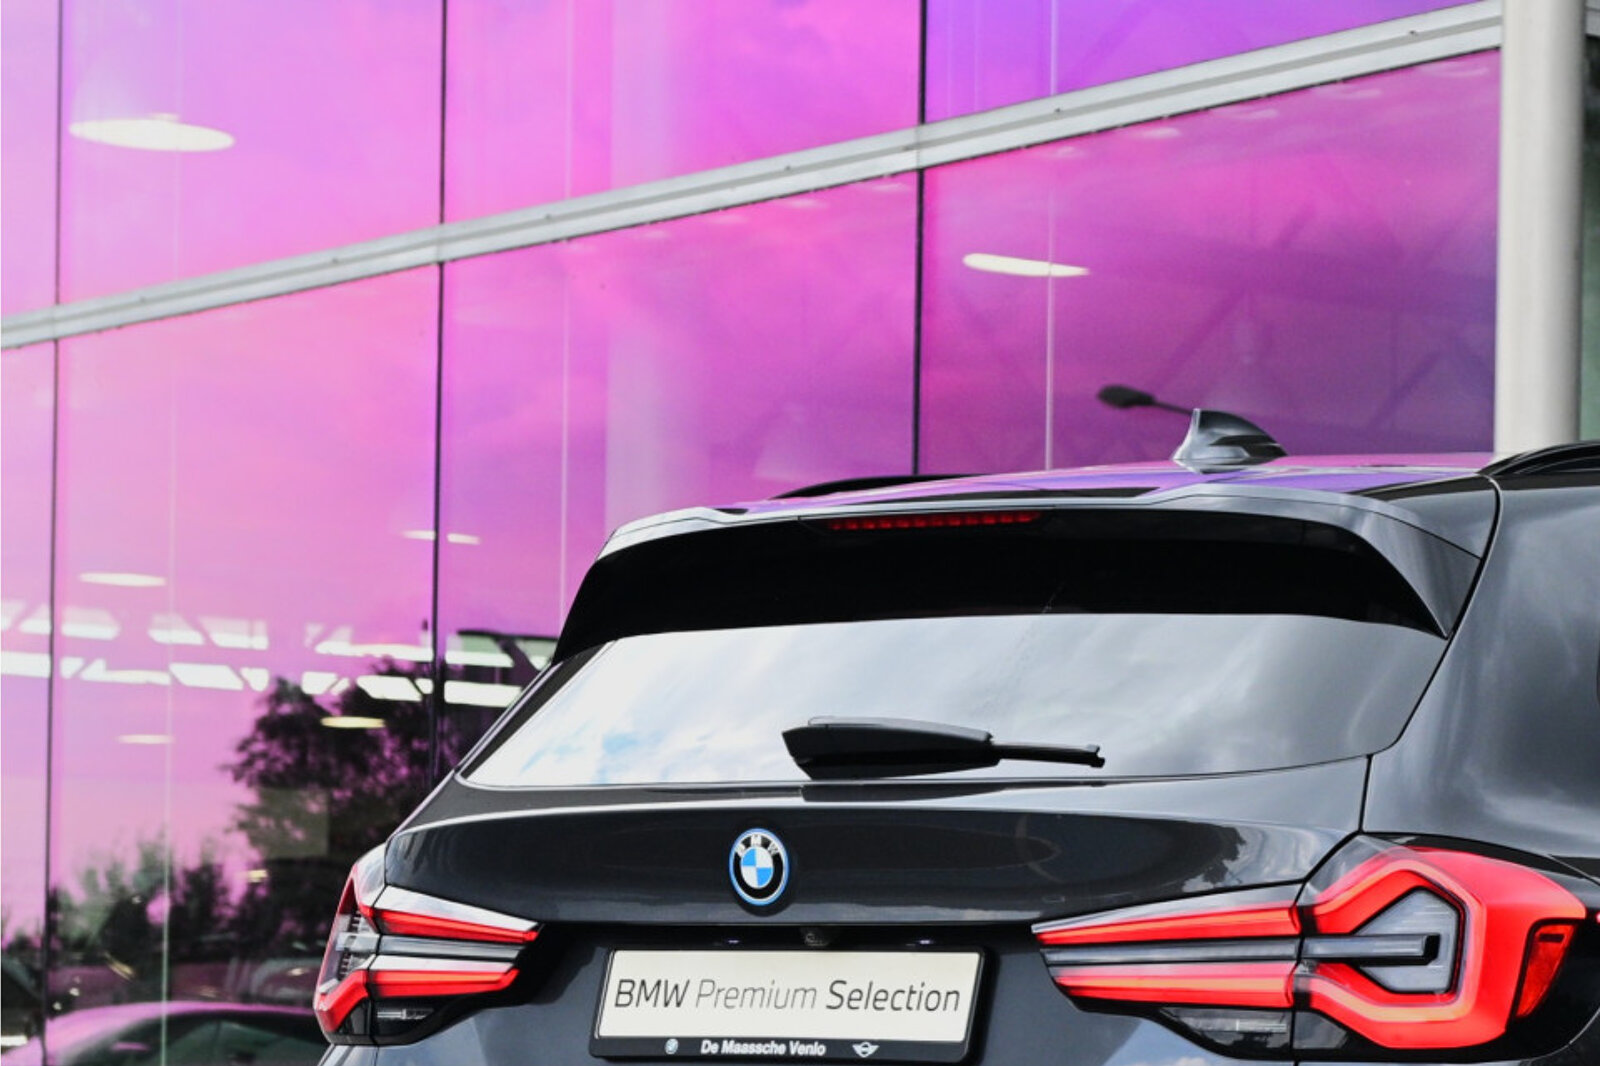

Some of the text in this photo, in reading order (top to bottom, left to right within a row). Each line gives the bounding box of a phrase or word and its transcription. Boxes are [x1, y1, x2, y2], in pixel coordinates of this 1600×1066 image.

[735, 832, 780, 857] BMW
[614, 978, 960, 1012] BMW Premium Selection
[700, 1039, 827, 1057] De Maassche Venlo
